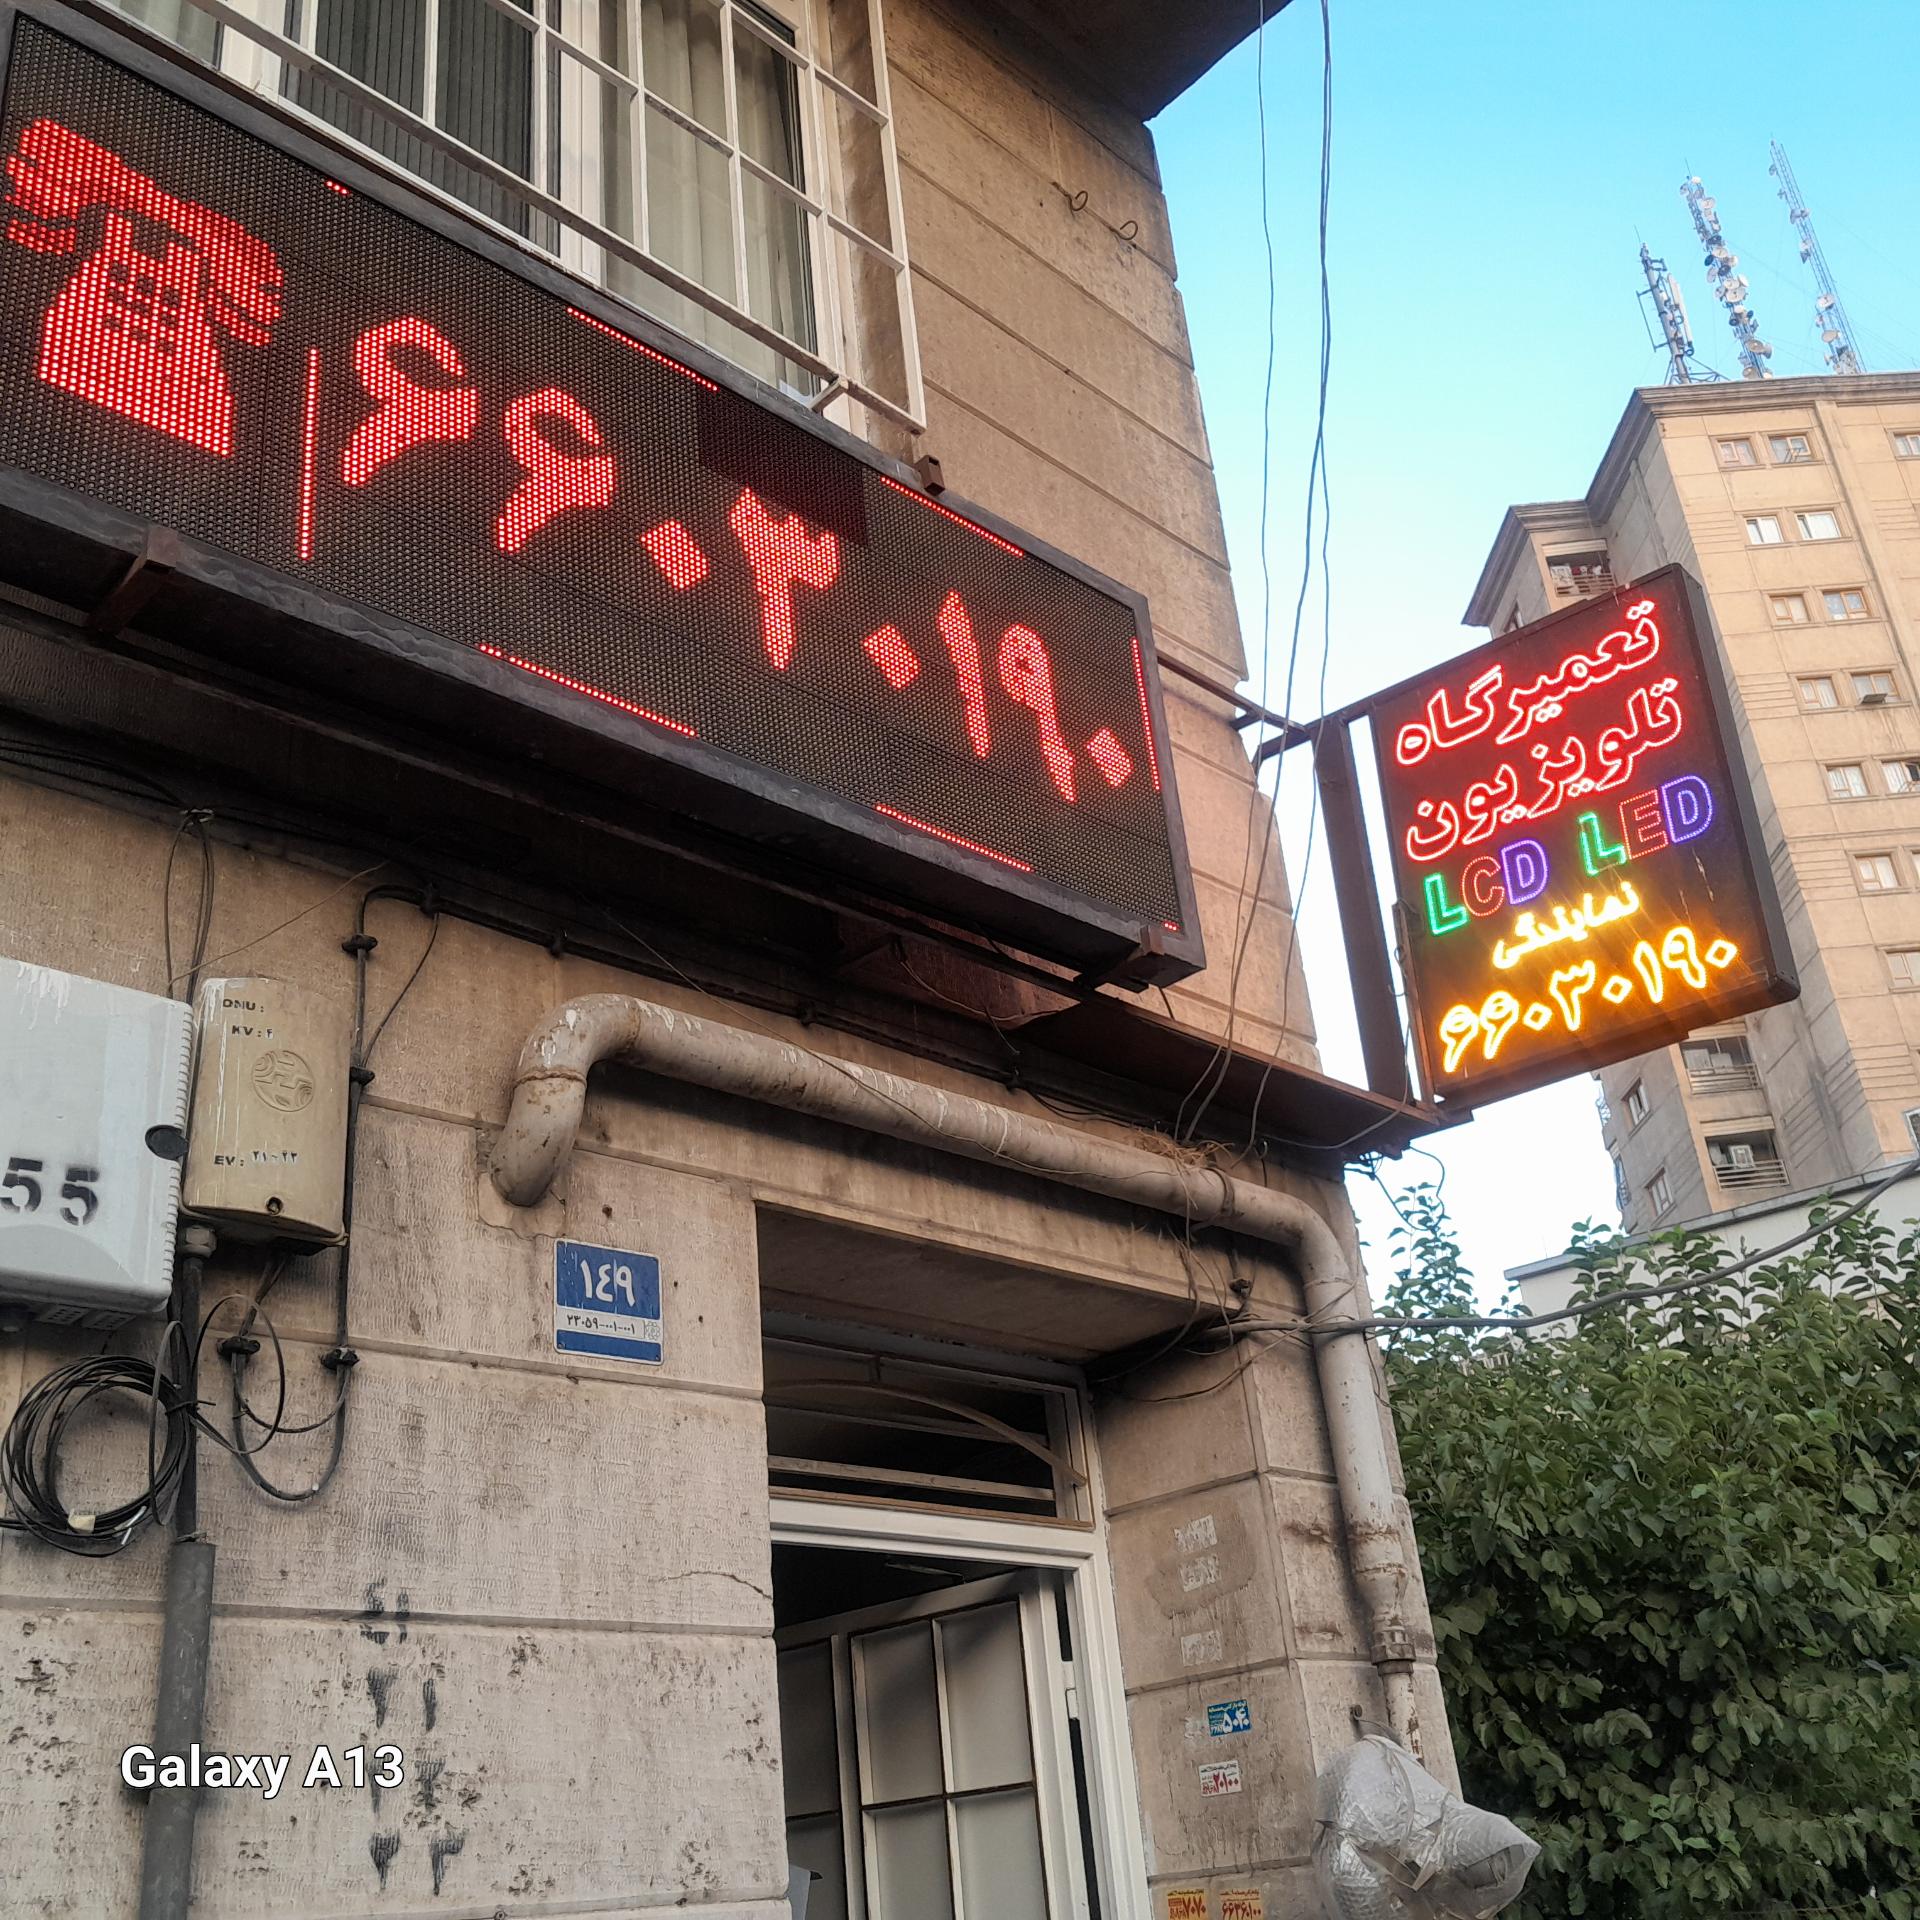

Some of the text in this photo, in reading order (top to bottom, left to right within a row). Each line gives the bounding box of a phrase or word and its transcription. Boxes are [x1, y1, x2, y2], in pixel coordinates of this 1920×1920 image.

[1397, 601, 1659, 765] تعمیرگاه
[1406, 677, 1681, 861] تلویزیون
[1424, 774, 1713, 935] LCD LED
[1493, 881, 1640, 968] نمایندگی
